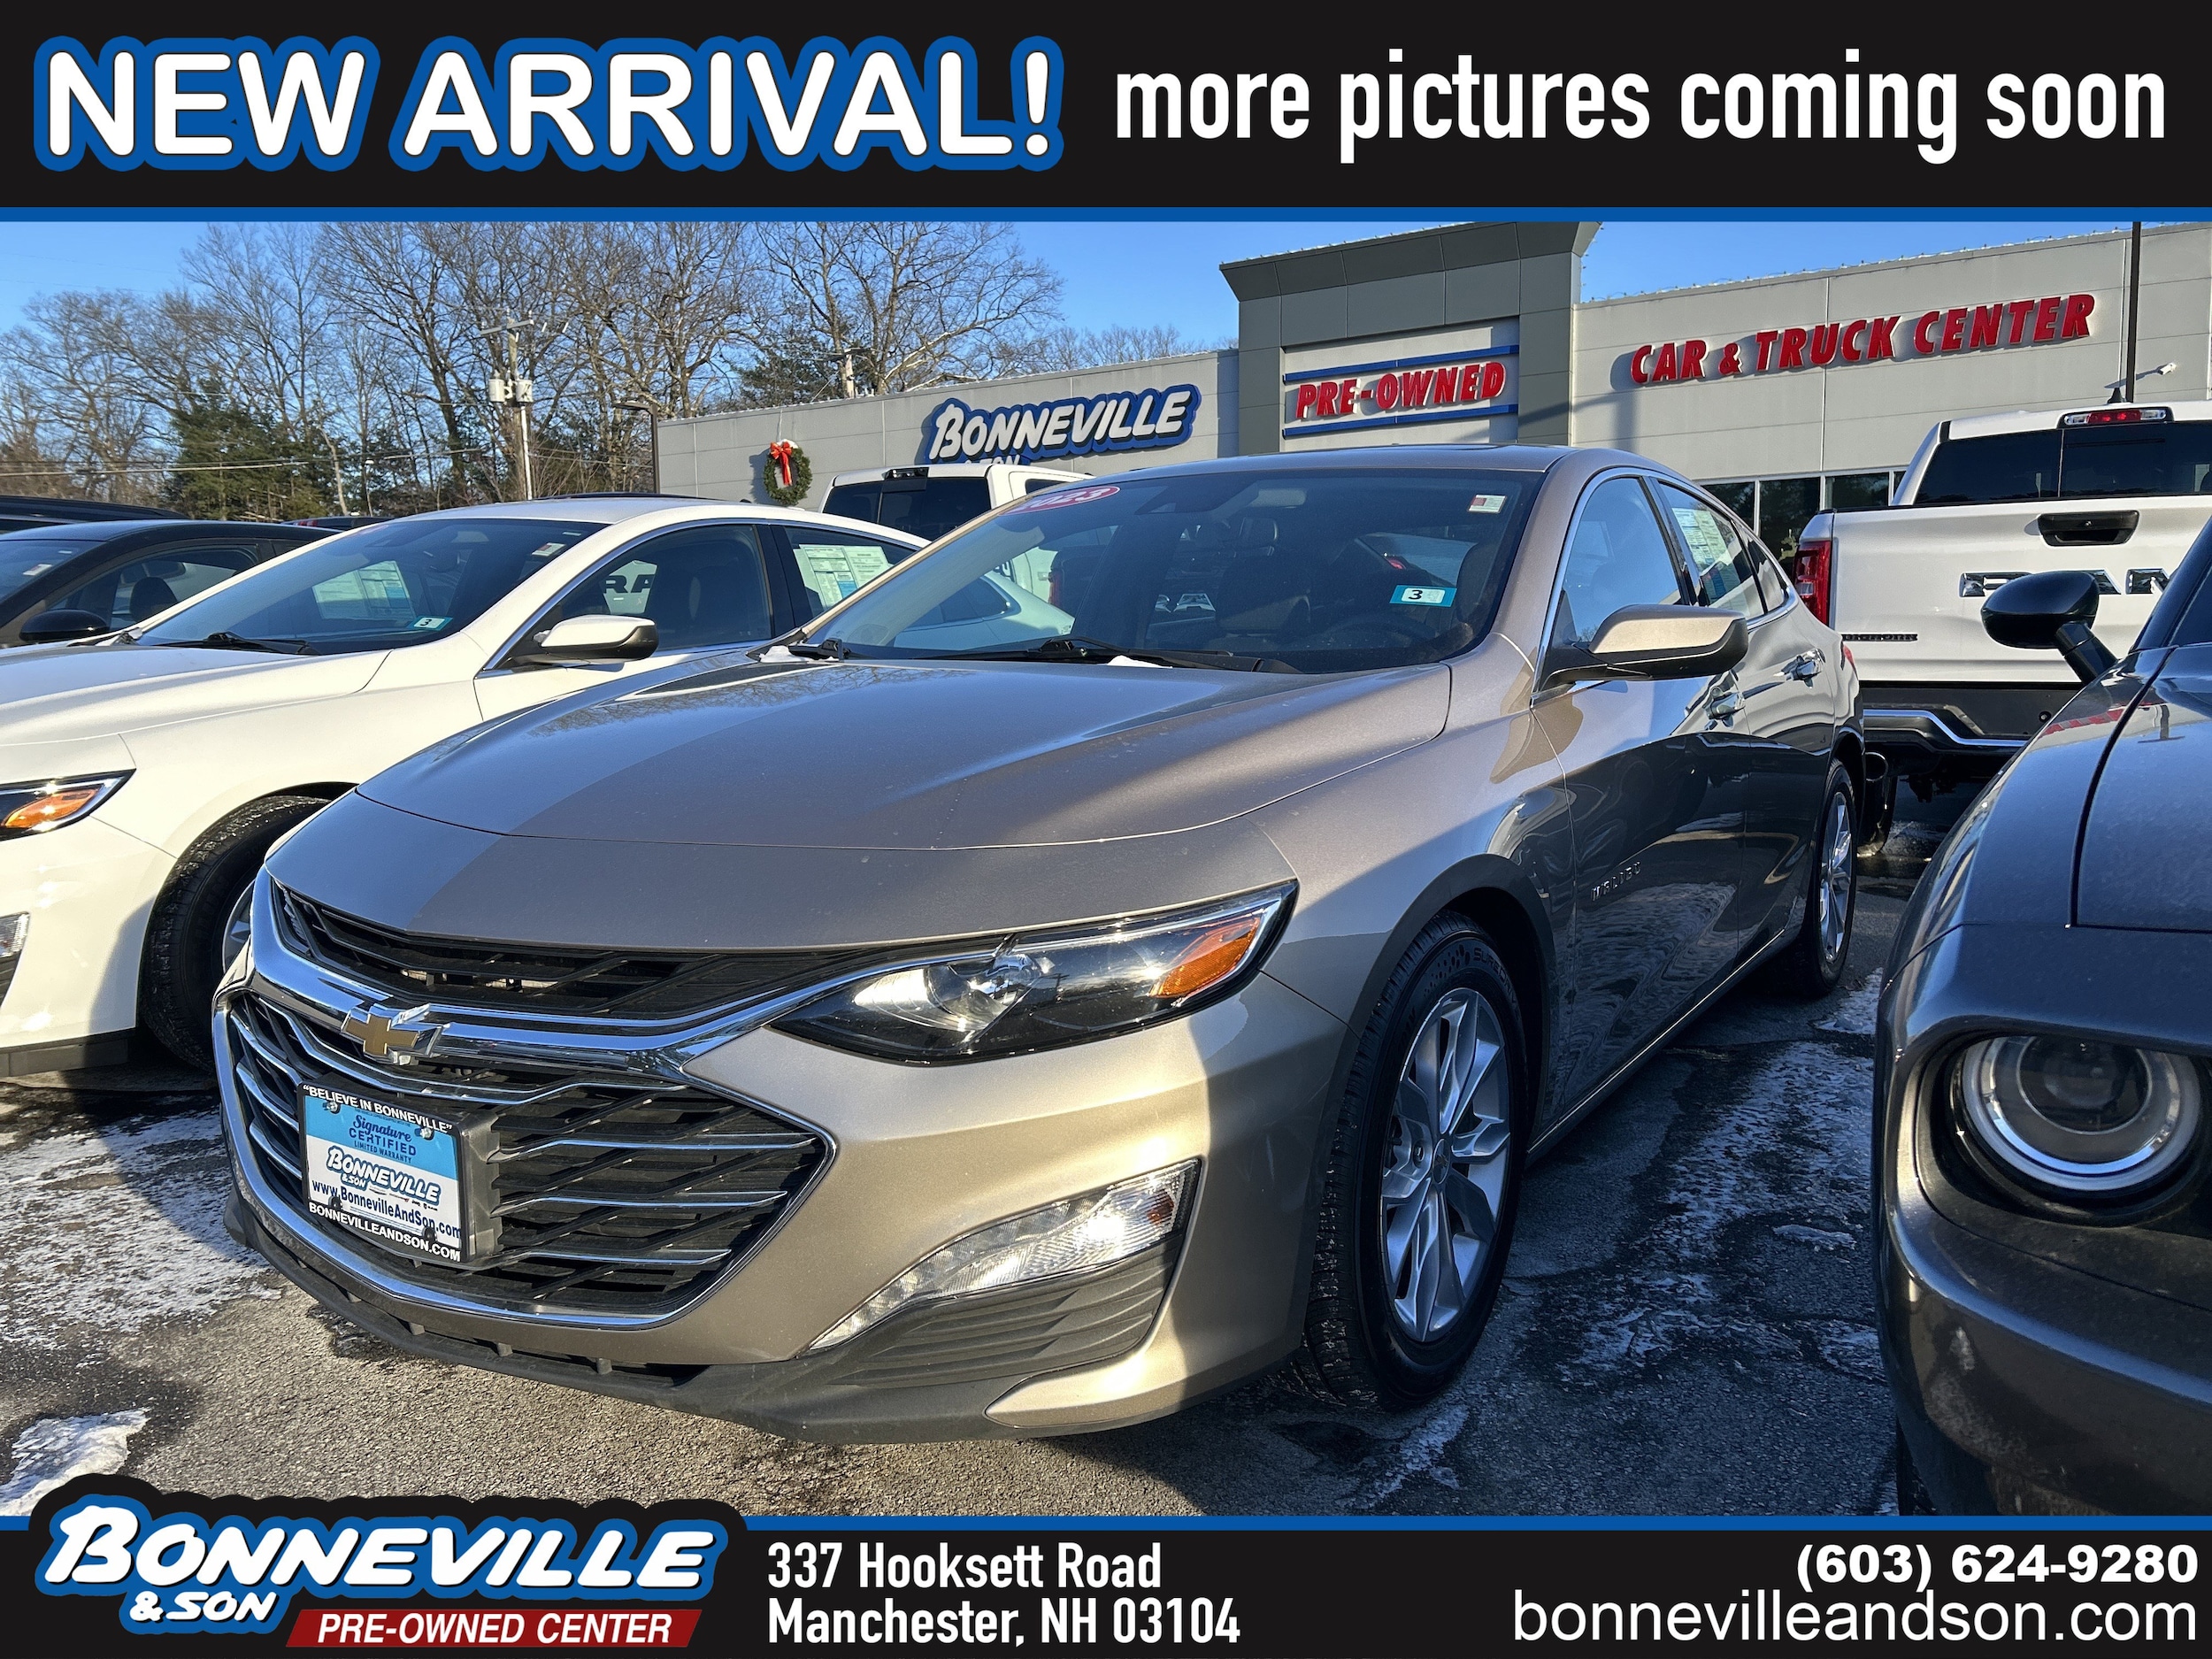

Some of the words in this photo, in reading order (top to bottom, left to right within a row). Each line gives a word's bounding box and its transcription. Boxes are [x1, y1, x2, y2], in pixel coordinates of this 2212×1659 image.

[1631, 340, 1707, 384] CAR
[1719, 342, 1742, 376] &
[1755, 315, 1901, 371] TRUCK
[1913, 294, 2095, 354] CENTER
[1295, 361, 1506, 419] PRE-OWNED
[929, 390, 1192, 460] BONNEVILLE
[1408, 589, 1424, 600] 3
[353, 1114, 412, 1142] Signature
[360, 1099, 372, 1111] IN
[349, 1128, 417, 1156] CERTIFIED
[354, 1141, 378, 1154] LIMITED
[380, 1148, 412, 1164] WARRANTY
[328, 1148, 440, 1202] BONNEVILLE
[309, 1202, 461, 1262] BONNEVILLEANDSON.COM
[312, 1180, 461, 1240] www.BonnevilleAndSon.com
